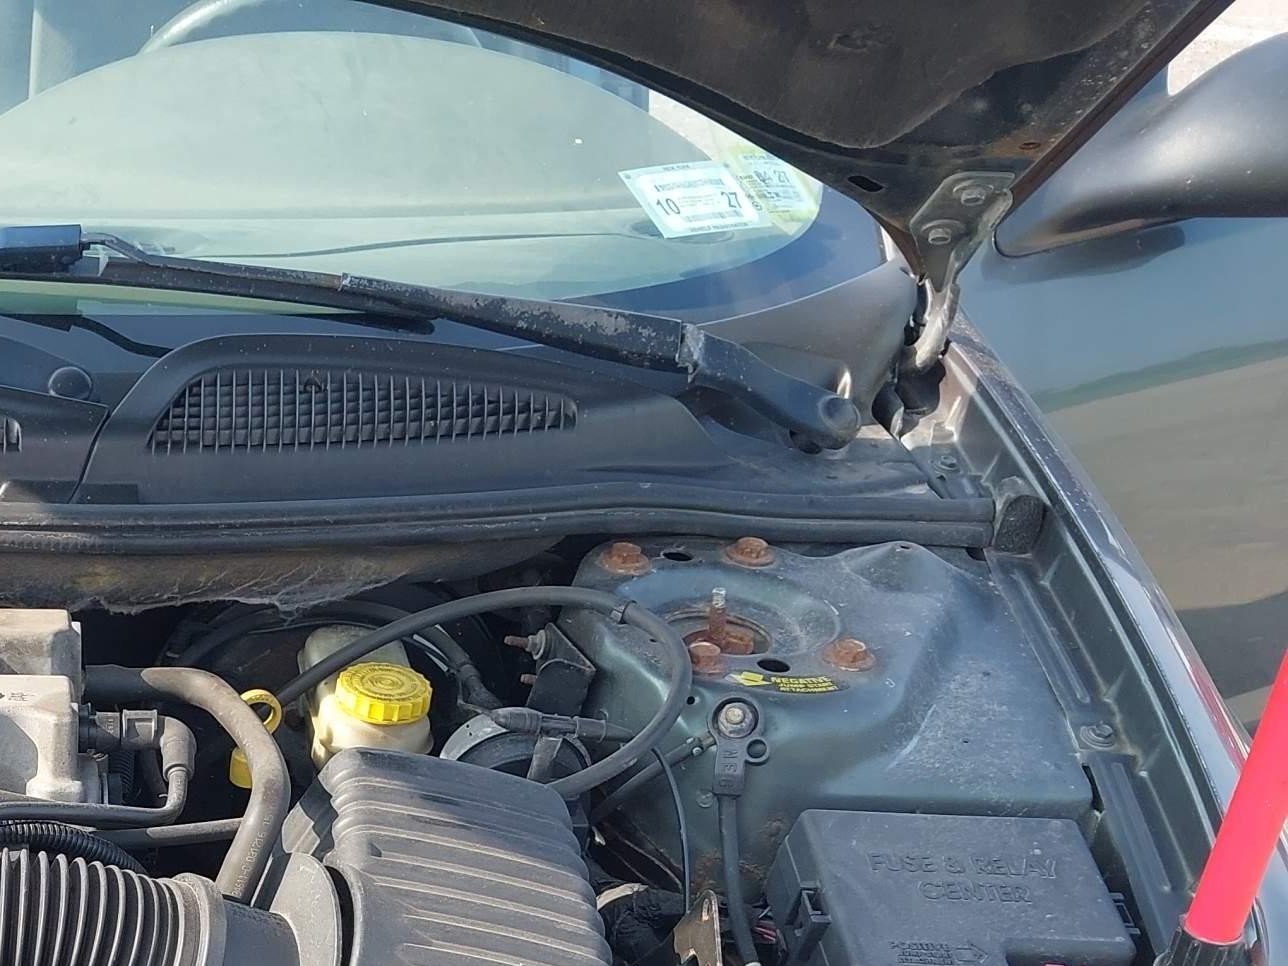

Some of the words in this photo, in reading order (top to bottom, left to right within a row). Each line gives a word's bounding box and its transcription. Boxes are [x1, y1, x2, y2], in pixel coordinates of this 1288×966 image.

[655, 198, 681, 216] 10
[721, 191, 742, 209] 27
[866, 853, 936, 873] FUSE
[942, 855, 965, 874] &
[968, 856, 1056, 878] RELAY
[918, 880, 1032, 904] CENTER
